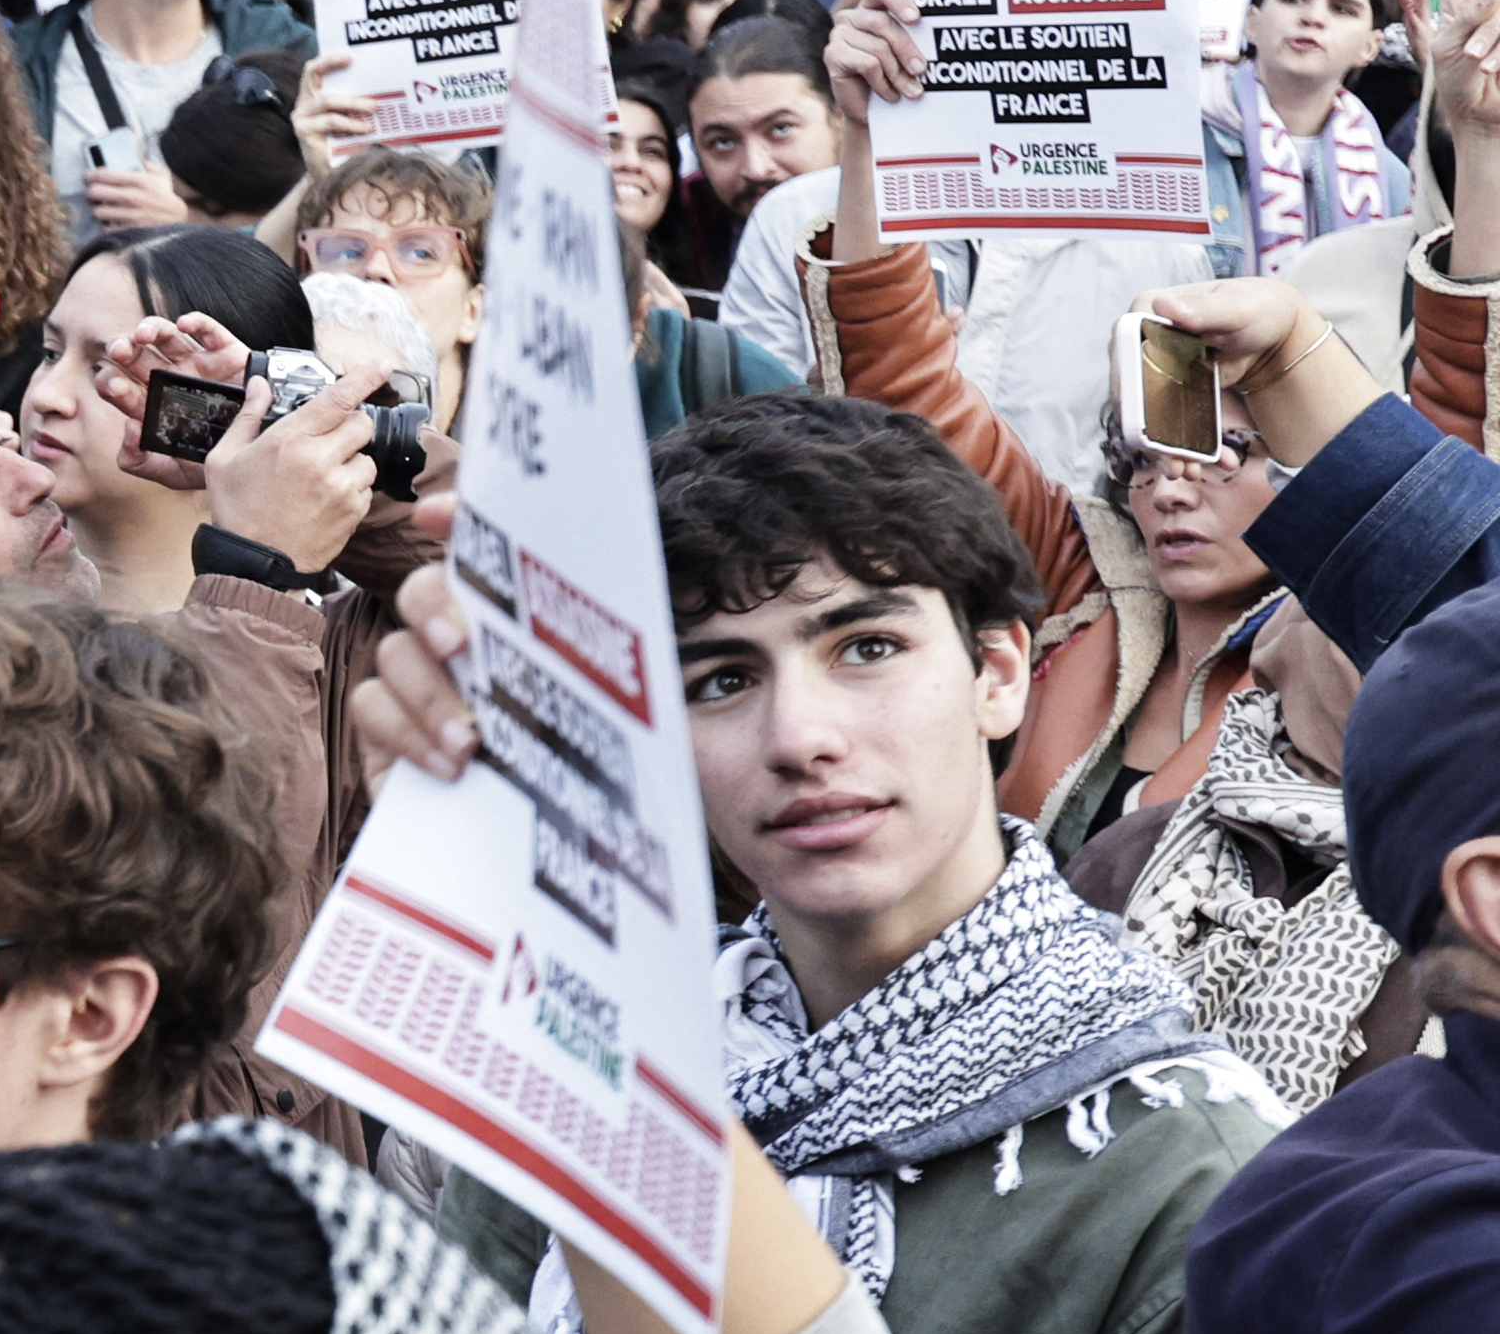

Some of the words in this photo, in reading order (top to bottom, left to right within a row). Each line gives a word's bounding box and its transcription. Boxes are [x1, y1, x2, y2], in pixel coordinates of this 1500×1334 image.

[348, 10, 501, 41] INCONDITIONNEL
[416, 31, 494, 59] FRANCE
[940, 28, 996, 51] AVEC
[999, 27, 1026, 49] LE
[1030, 24, 1128, 49] SOUTIEN
[438, 69, 508, 88] URGENCE
[921, 59, 1094, 85] NCONDITIONNEL
[1097, 59, 1127, 81] DE
[1130, 58, 1163, 81] LA
[442, 81, 509, 101] PALESTIN
[995, 93, 1085, 116] FRANCE
[1019, 143, 1099, 158] URGENCE
[1022, 160, 1108, 175] PALESTINE
